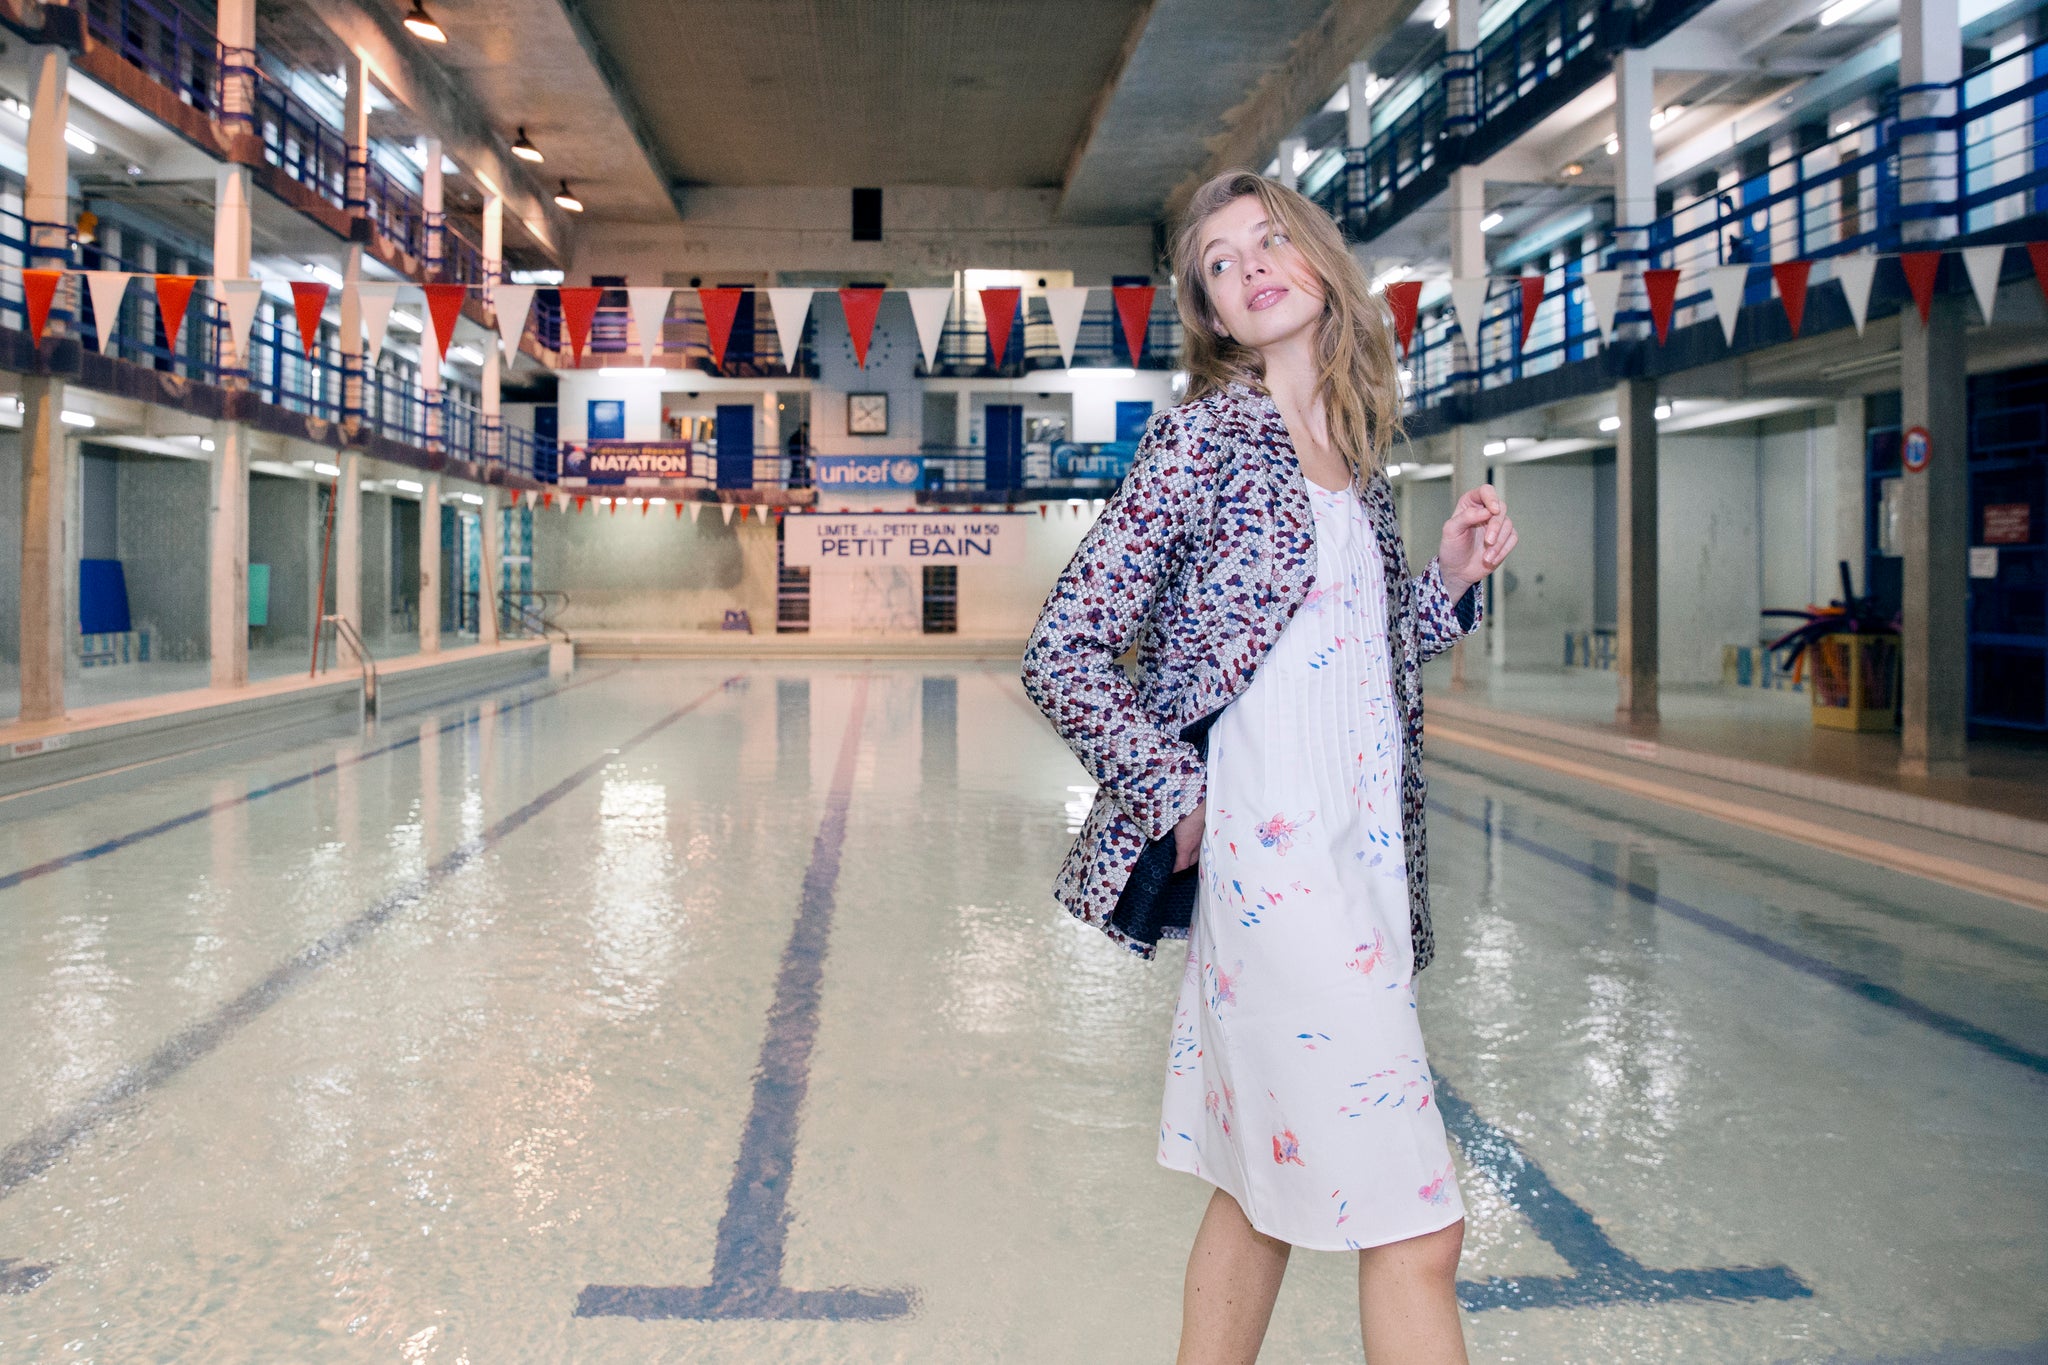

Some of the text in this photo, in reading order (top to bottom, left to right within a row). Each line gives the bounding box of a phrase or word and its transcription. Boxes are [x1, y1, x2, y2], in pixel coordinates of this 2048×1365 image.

[590, 455, 687, 472] NATATION
[820, 459, 890, 483] unicef
[817, 524, 857, 536] LIMITE
[883, 524, 918, 536] PETIT
[923, 524, 955, 536] BAIN
[822, 538, 991, 556] PETIT BAIN
